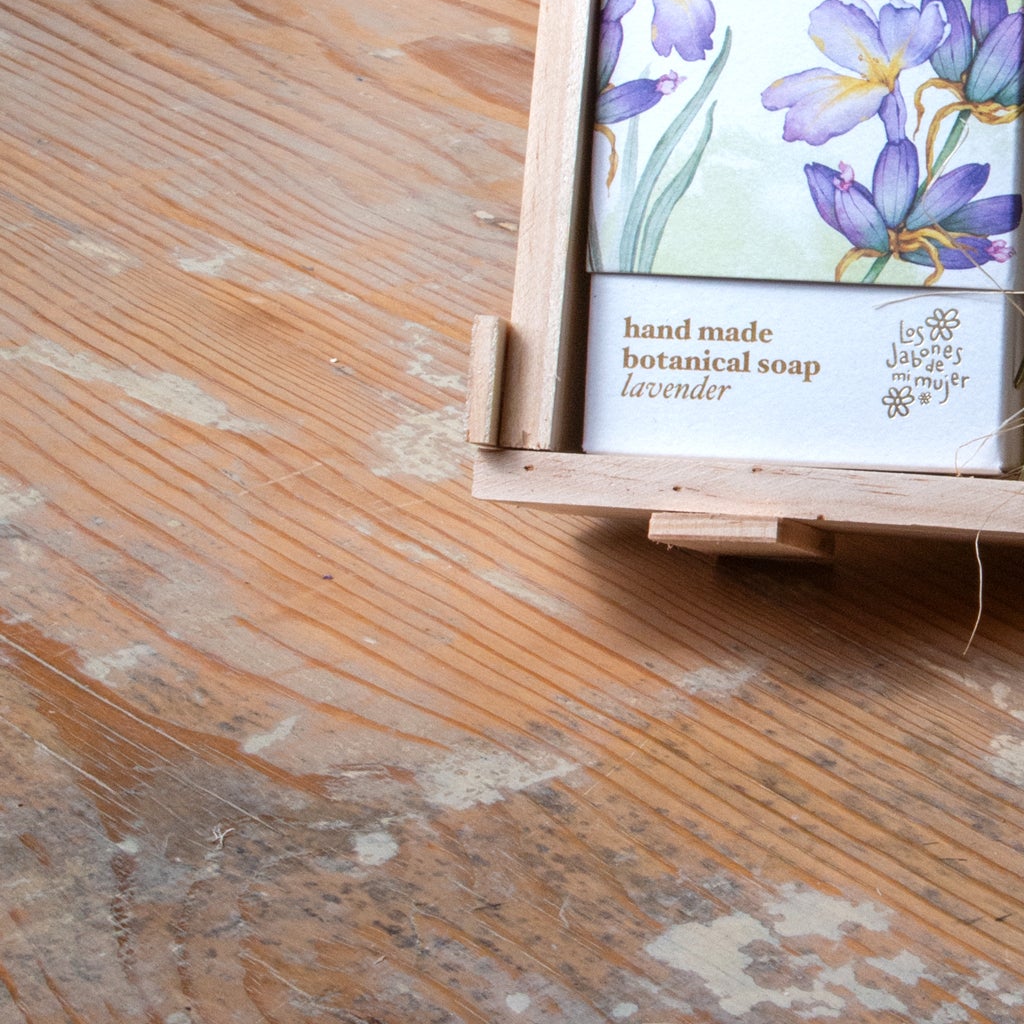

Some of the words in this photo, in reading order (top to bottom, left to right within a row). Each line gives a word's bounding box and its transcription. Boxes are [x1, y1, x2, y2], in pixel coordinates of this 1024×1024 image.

[623, 316, 691, 341] hand
[697, 320, 773, 343] made
[900, 320, 924, 346] Los
[622, 346, 751, 373] botanical
[757, 358, 821, 382] soap
[886, 342, 963, 368] Jabones
[925, 359, 944, 372] de
[621, 372, 731, 401] lavender
[892, 370, 910, 381] mi
[915, 372, 970, 404] mujer
